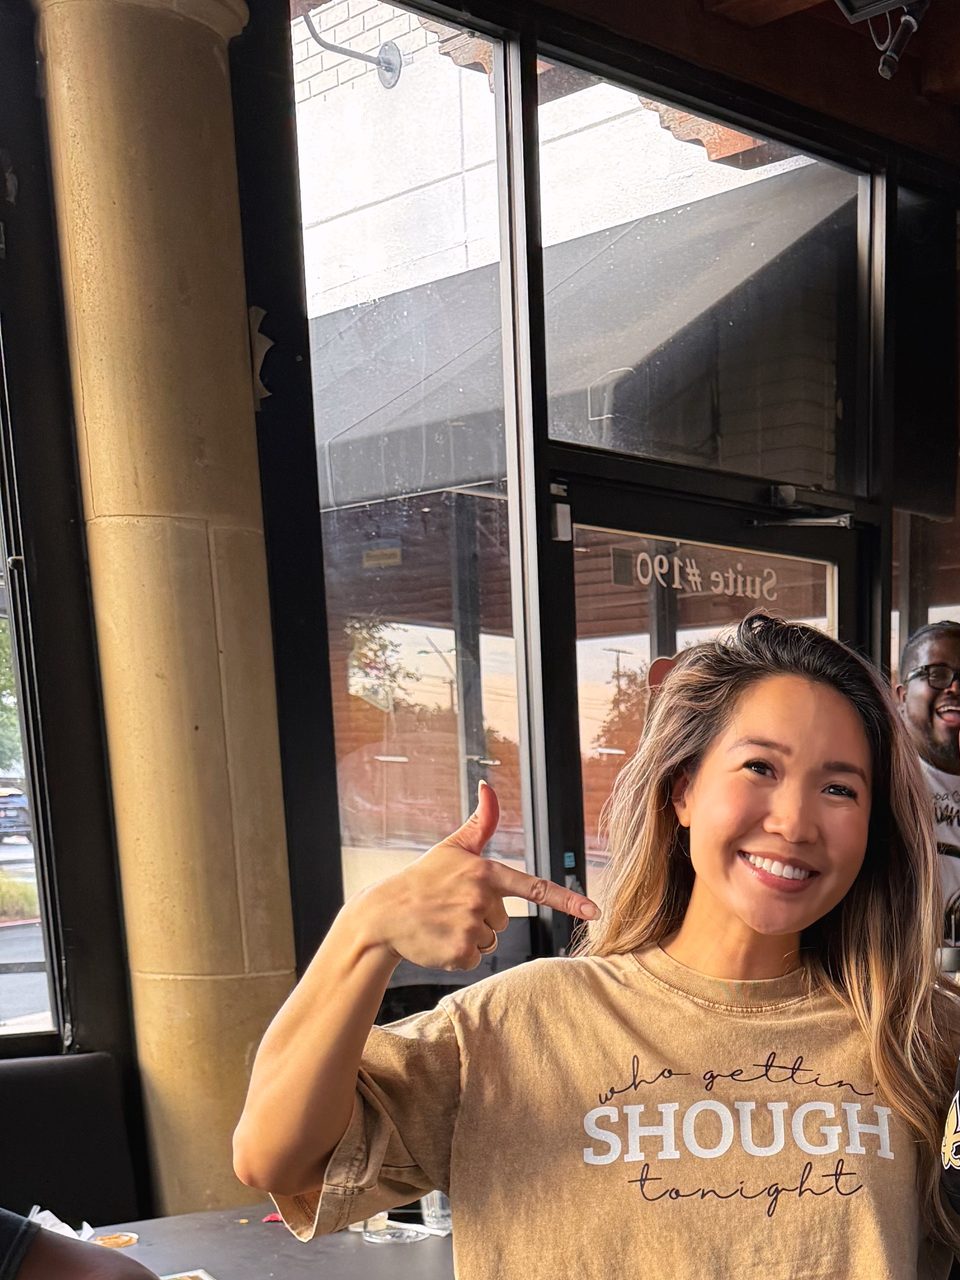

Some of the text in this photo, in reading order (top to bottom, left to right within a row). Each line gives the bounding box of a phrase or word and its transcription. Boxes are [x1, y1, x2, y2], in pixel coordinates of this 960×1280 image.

[598, 1054, 691, 1105] who
[583, 1099, 895, 1165] SHOUGH
[627, 1158, 864, 1218] tonight
